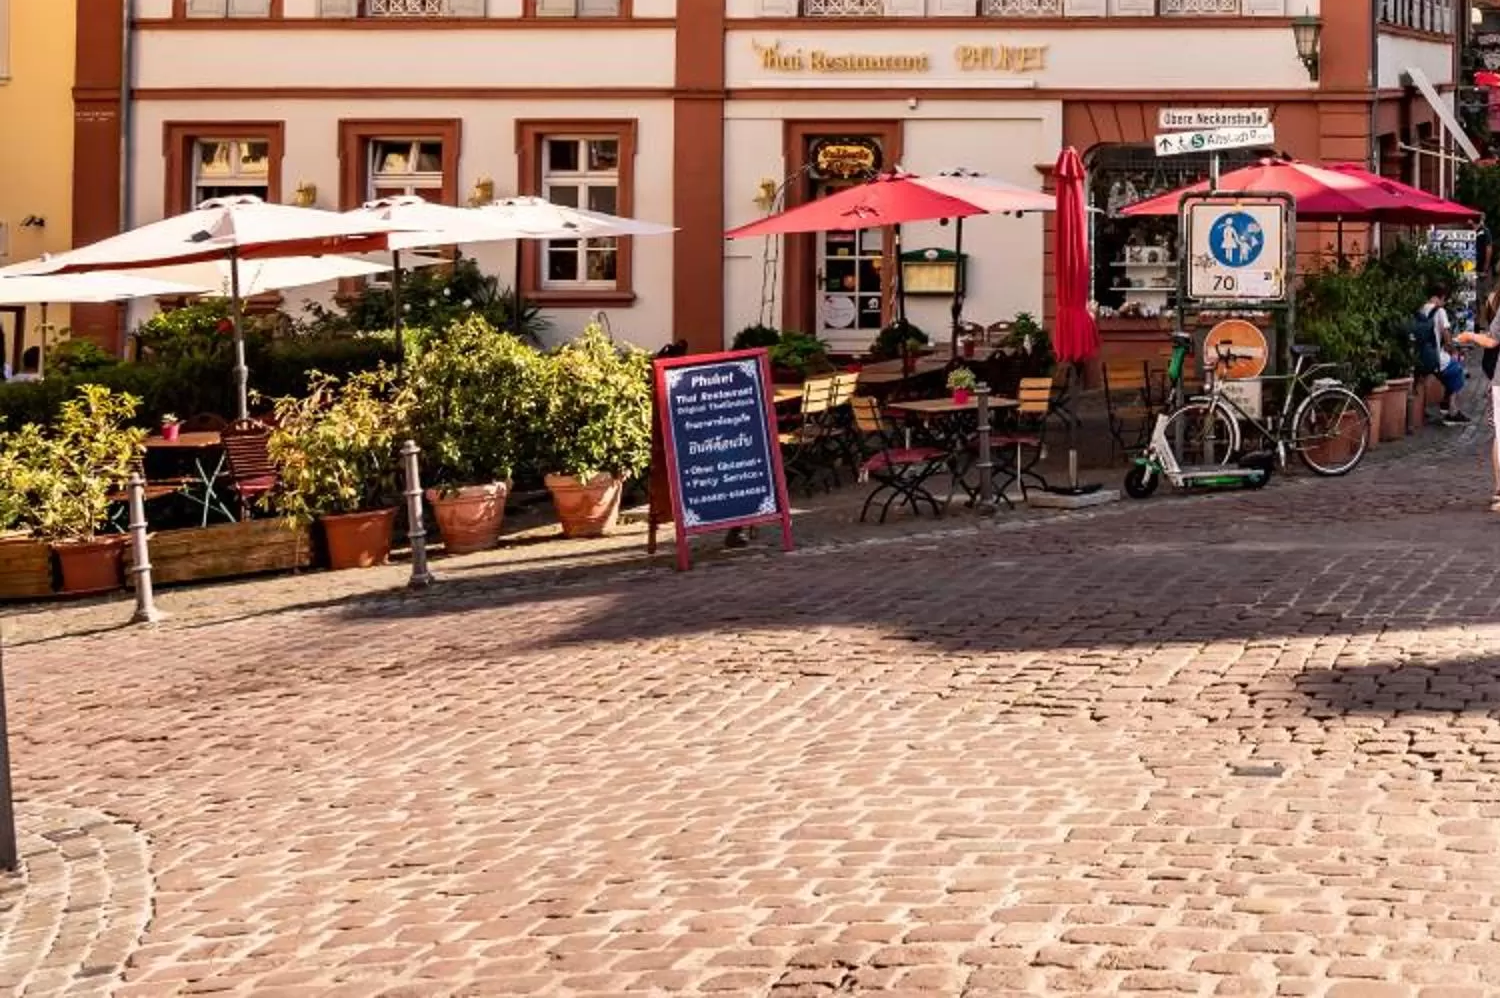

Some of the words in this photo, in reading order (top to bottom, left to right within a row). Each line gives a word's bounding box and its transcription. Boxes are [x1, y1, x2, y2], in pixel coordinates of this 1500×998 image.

[810, 51, 929, 73] Restaurant
[1164, 113, 1192, 124] Obere
[1198, 112, 1262, 124] Neckarstraße
[691, 371, 733, 388] Phuket
[676, 393, 697, 404] Thai
[701, 386, 753, 401] Restaurant
